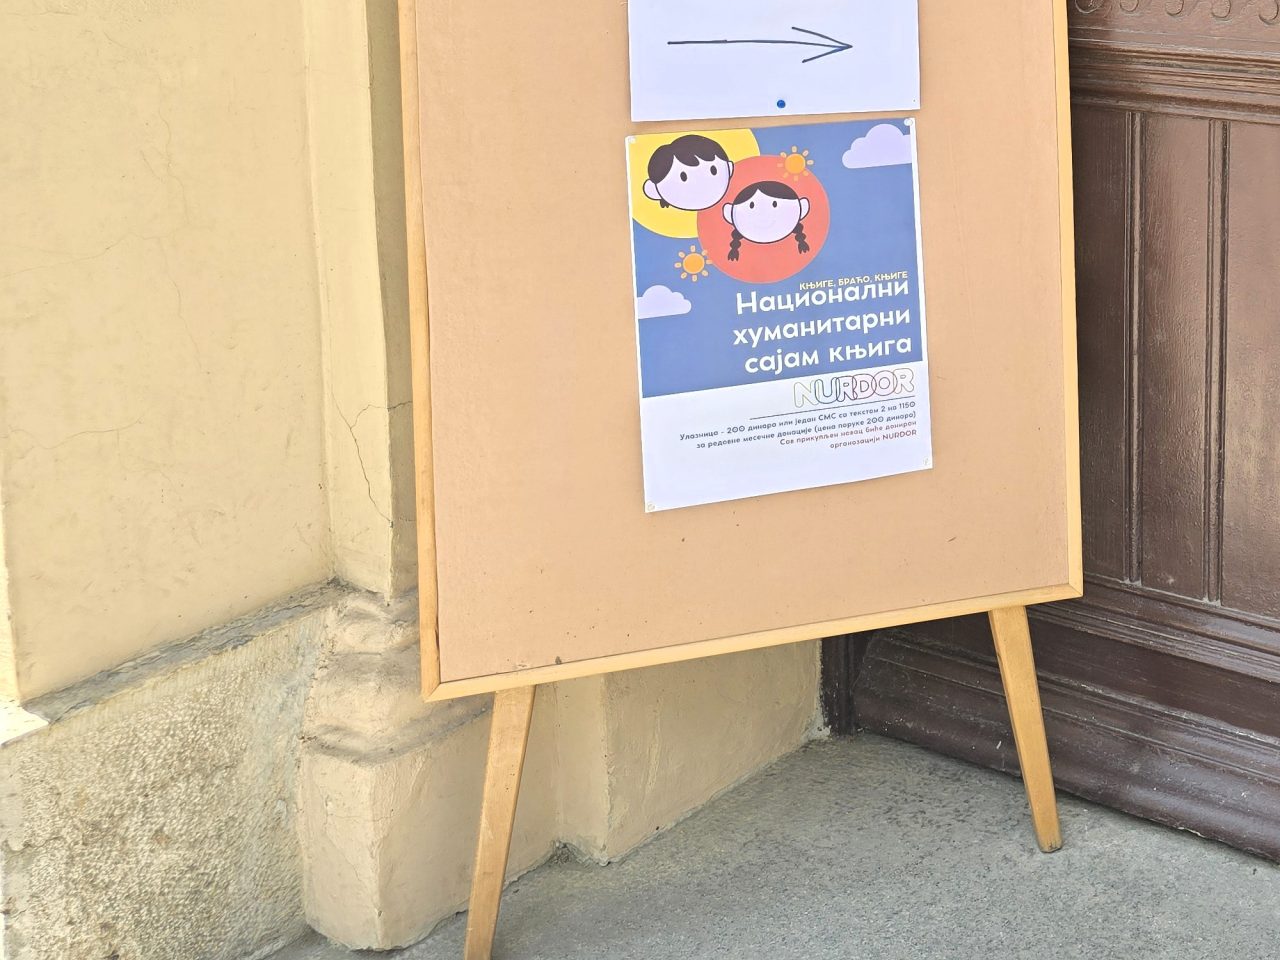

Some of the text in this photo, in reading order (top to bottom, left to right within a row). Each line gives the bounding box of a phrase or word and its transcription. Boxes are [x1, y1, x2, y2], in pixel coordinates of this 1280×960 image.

[799, 270, 908, 290] КЊИГЕ, БРАЋО, КЊИГЕ
[736, 281, 909, 315] Национални
[733, 309, 910, 349] хуманитарни
[744, 337, 911, 375] сајам књига
[793, 368, 915, 408] NURDOR
[726, 424, 746, 434] 200
[817, 412, 836, 421] СМС
[898, 400, 916, 409] 1150
[837, 420, 865, 429] поруке
[866, 415, 884, 425] 200
[882, 429, 917, 440] NURDOR
